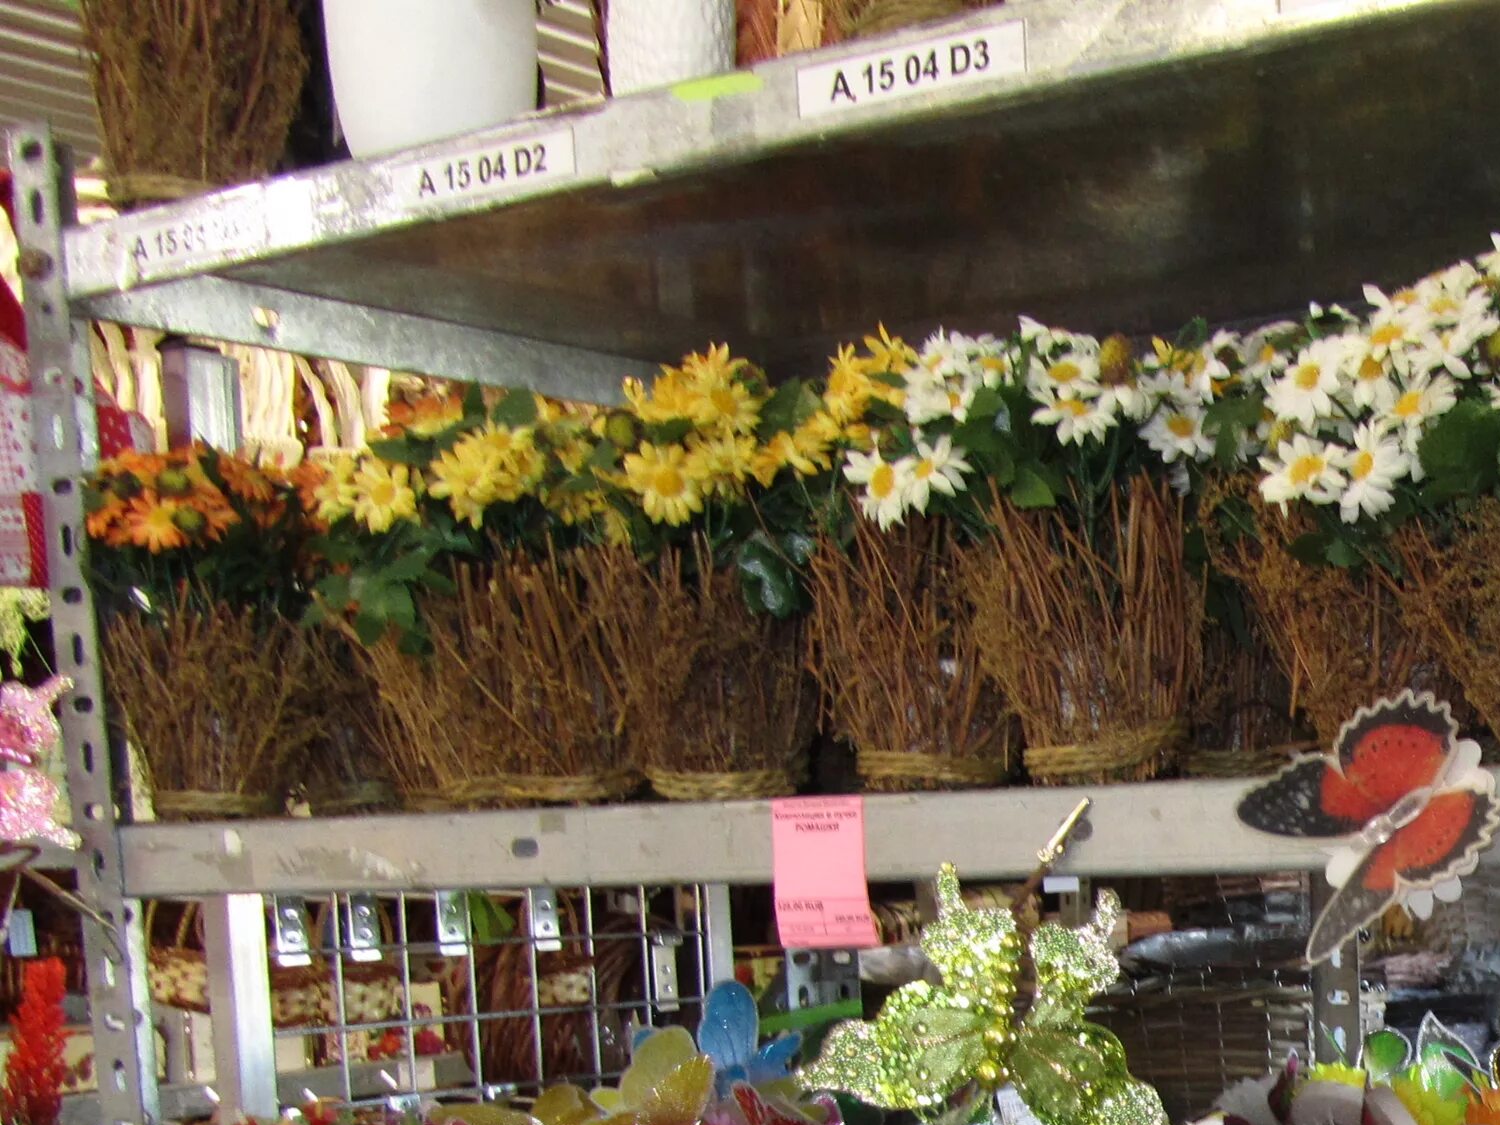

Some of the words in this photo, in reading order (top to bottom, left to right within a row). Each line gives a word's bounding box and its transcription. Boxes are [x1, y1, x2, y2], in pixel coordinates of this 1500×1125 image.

[831, 68, 853, 103] A
[862, 58, 895, 94] 15
[904, 47, 939, 86] 04
[951, 38, 990, 76] D3
[418, 167, 437, 197] A
[444, 161, 471, 191] 15
[478, 151, 507, 185] 04
[514, 142, 547, 177] D2
[133, 234, 149, 261] A
[156, 229, 178, 257] 15
